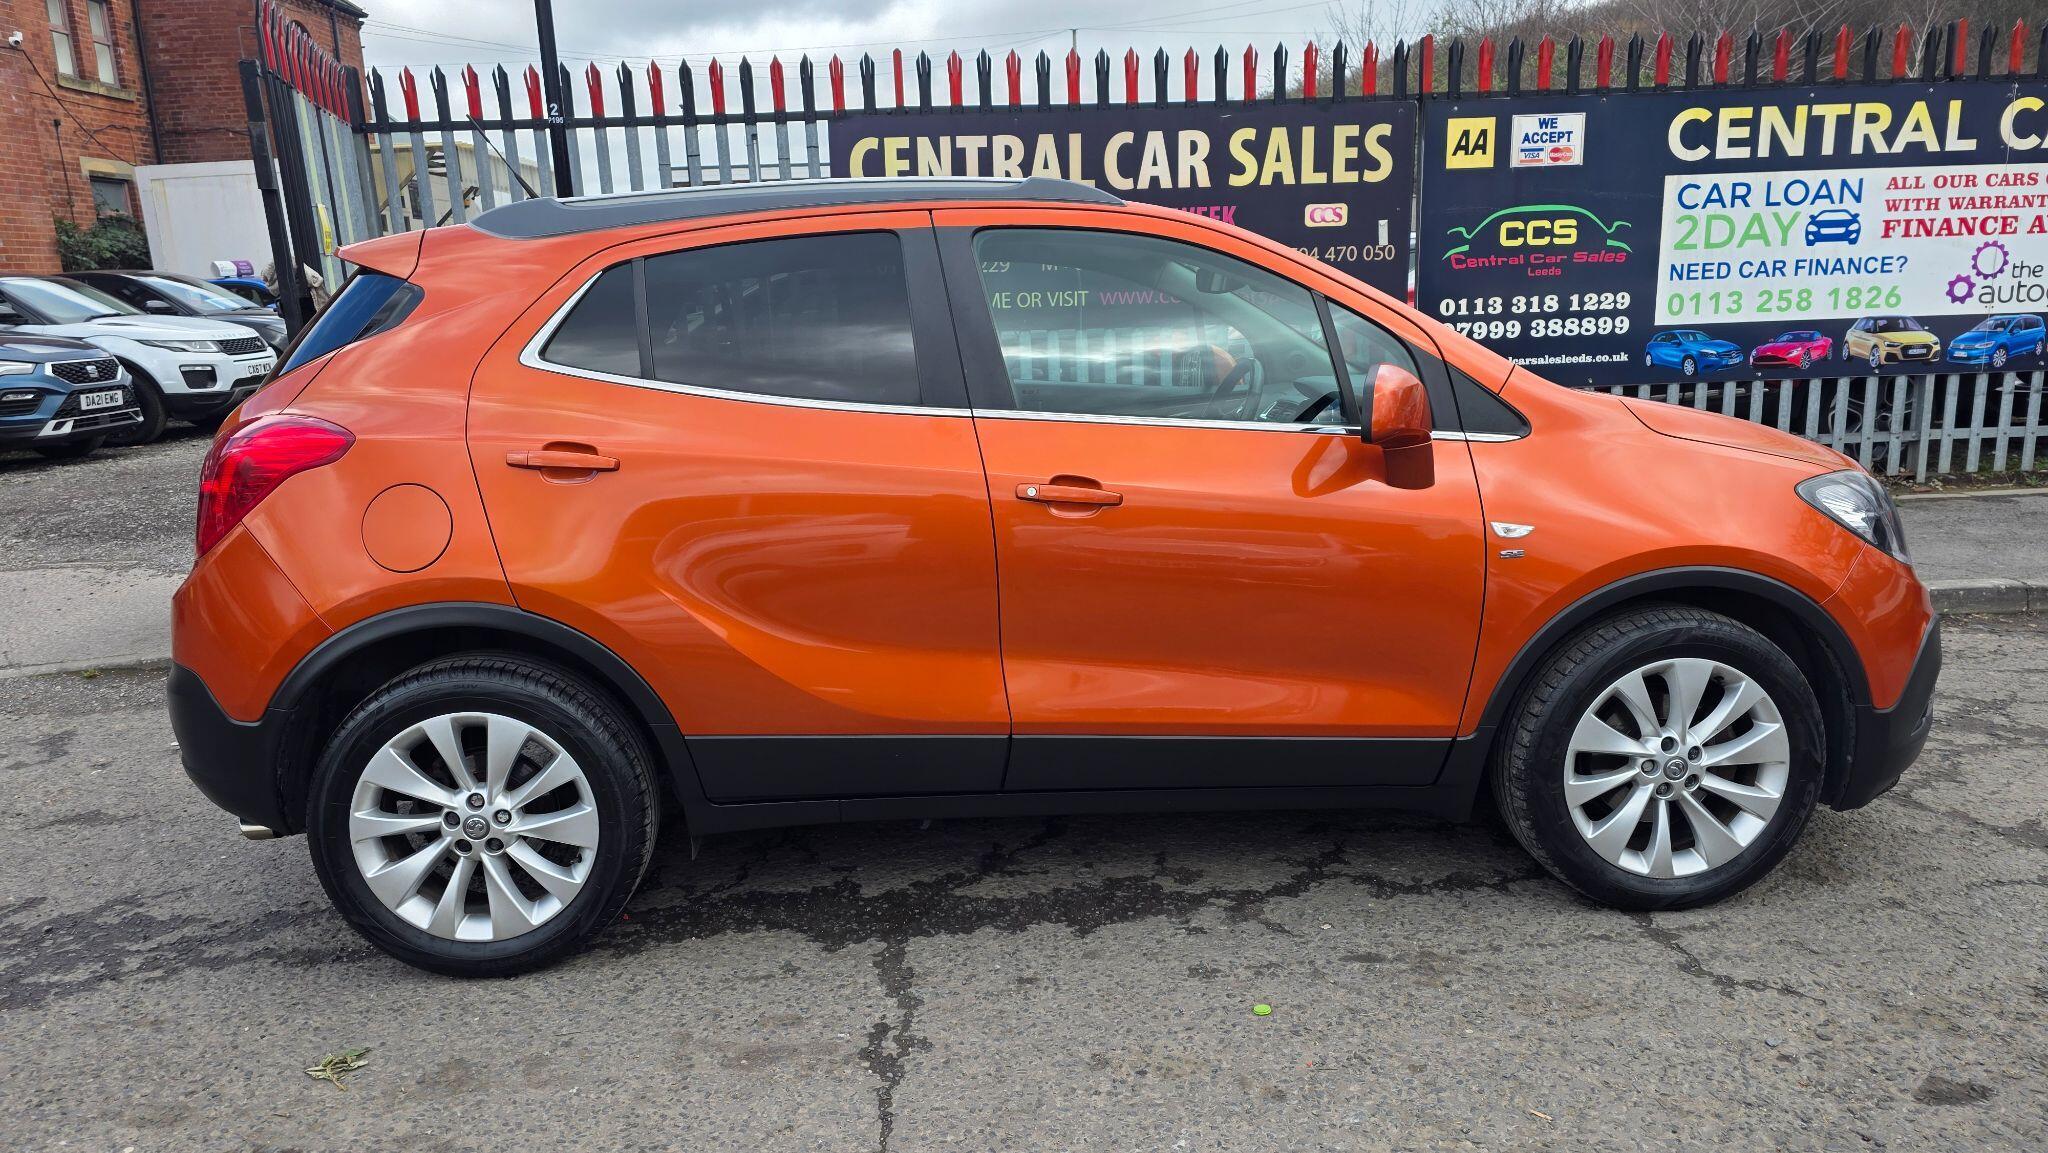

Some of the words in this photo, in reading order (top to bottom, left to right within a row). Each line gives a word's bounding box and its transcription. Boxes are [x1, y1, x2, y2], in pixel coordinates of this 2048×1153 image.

[550, 103, 558, 116] 2
[1538, 117, 1558, 129] WE
[1668, 100, 1977, 162] CENTRAL
[2001, 96, 2048, 150] C
[1452, 128, 1488, 156] AA
[1522, 131, 1573, 144] ACCEPT
[850, 133, 1096, 188] CENTRAL
[1104, 129, 1211, 191] CAR
[1228, 123, 1394, 187] SALES
[1886, 176, 1926, 190] ALL
[1933, 174, 1978, 188] OUR
[1985, 172, 2039, 187] CARS
[1677, 182, 1752, 210] CAR
[1765, 178, 1863, 206] LOAN
[1884, 197, 1941, 212] WITH
[1176, 206, 1236, 225] EK
[1500, 219, 1578, 247] CCS
[1673, 211, 1801, 250] 2DAY
[1881, 215, 2019, 239] FINANCE
[2027, 214, 2048, 234] A
[1325, 246, 1357, 261] 470
[1363, 244, 1395, 261] 050
[1451, 254, 1524, 269] Central
[1530, 253, 1567, 264] Car
[1573, 250, 1627, 263] Sales
[1528, 267, 1562, 276] Leeds
[1669, 262, 1731, 281] NEED
[1738, 260, 1786, 278] CAR
[1794, 255, 1908, 276] FINANCE?
[2011, 260, 2044, 278] the
[1017, 292, 1042, 308] OR
[1047, 291, 1089, 307] VISIT
[1667, 291, 1743, 316] 0113
[1756, 288, 1812, 313] 258
[1827, 285, 1901, 310] 1826
[1978, 281, 2048, 304] auto
[1439, 297, 1503, 316] 0113
[1511, 295, 1559, 313] 318
[1569, 292, 1631, 311] 1229
[1530, 316, 1630, 337] 388899
[85, 394, 104, 407] DA21
